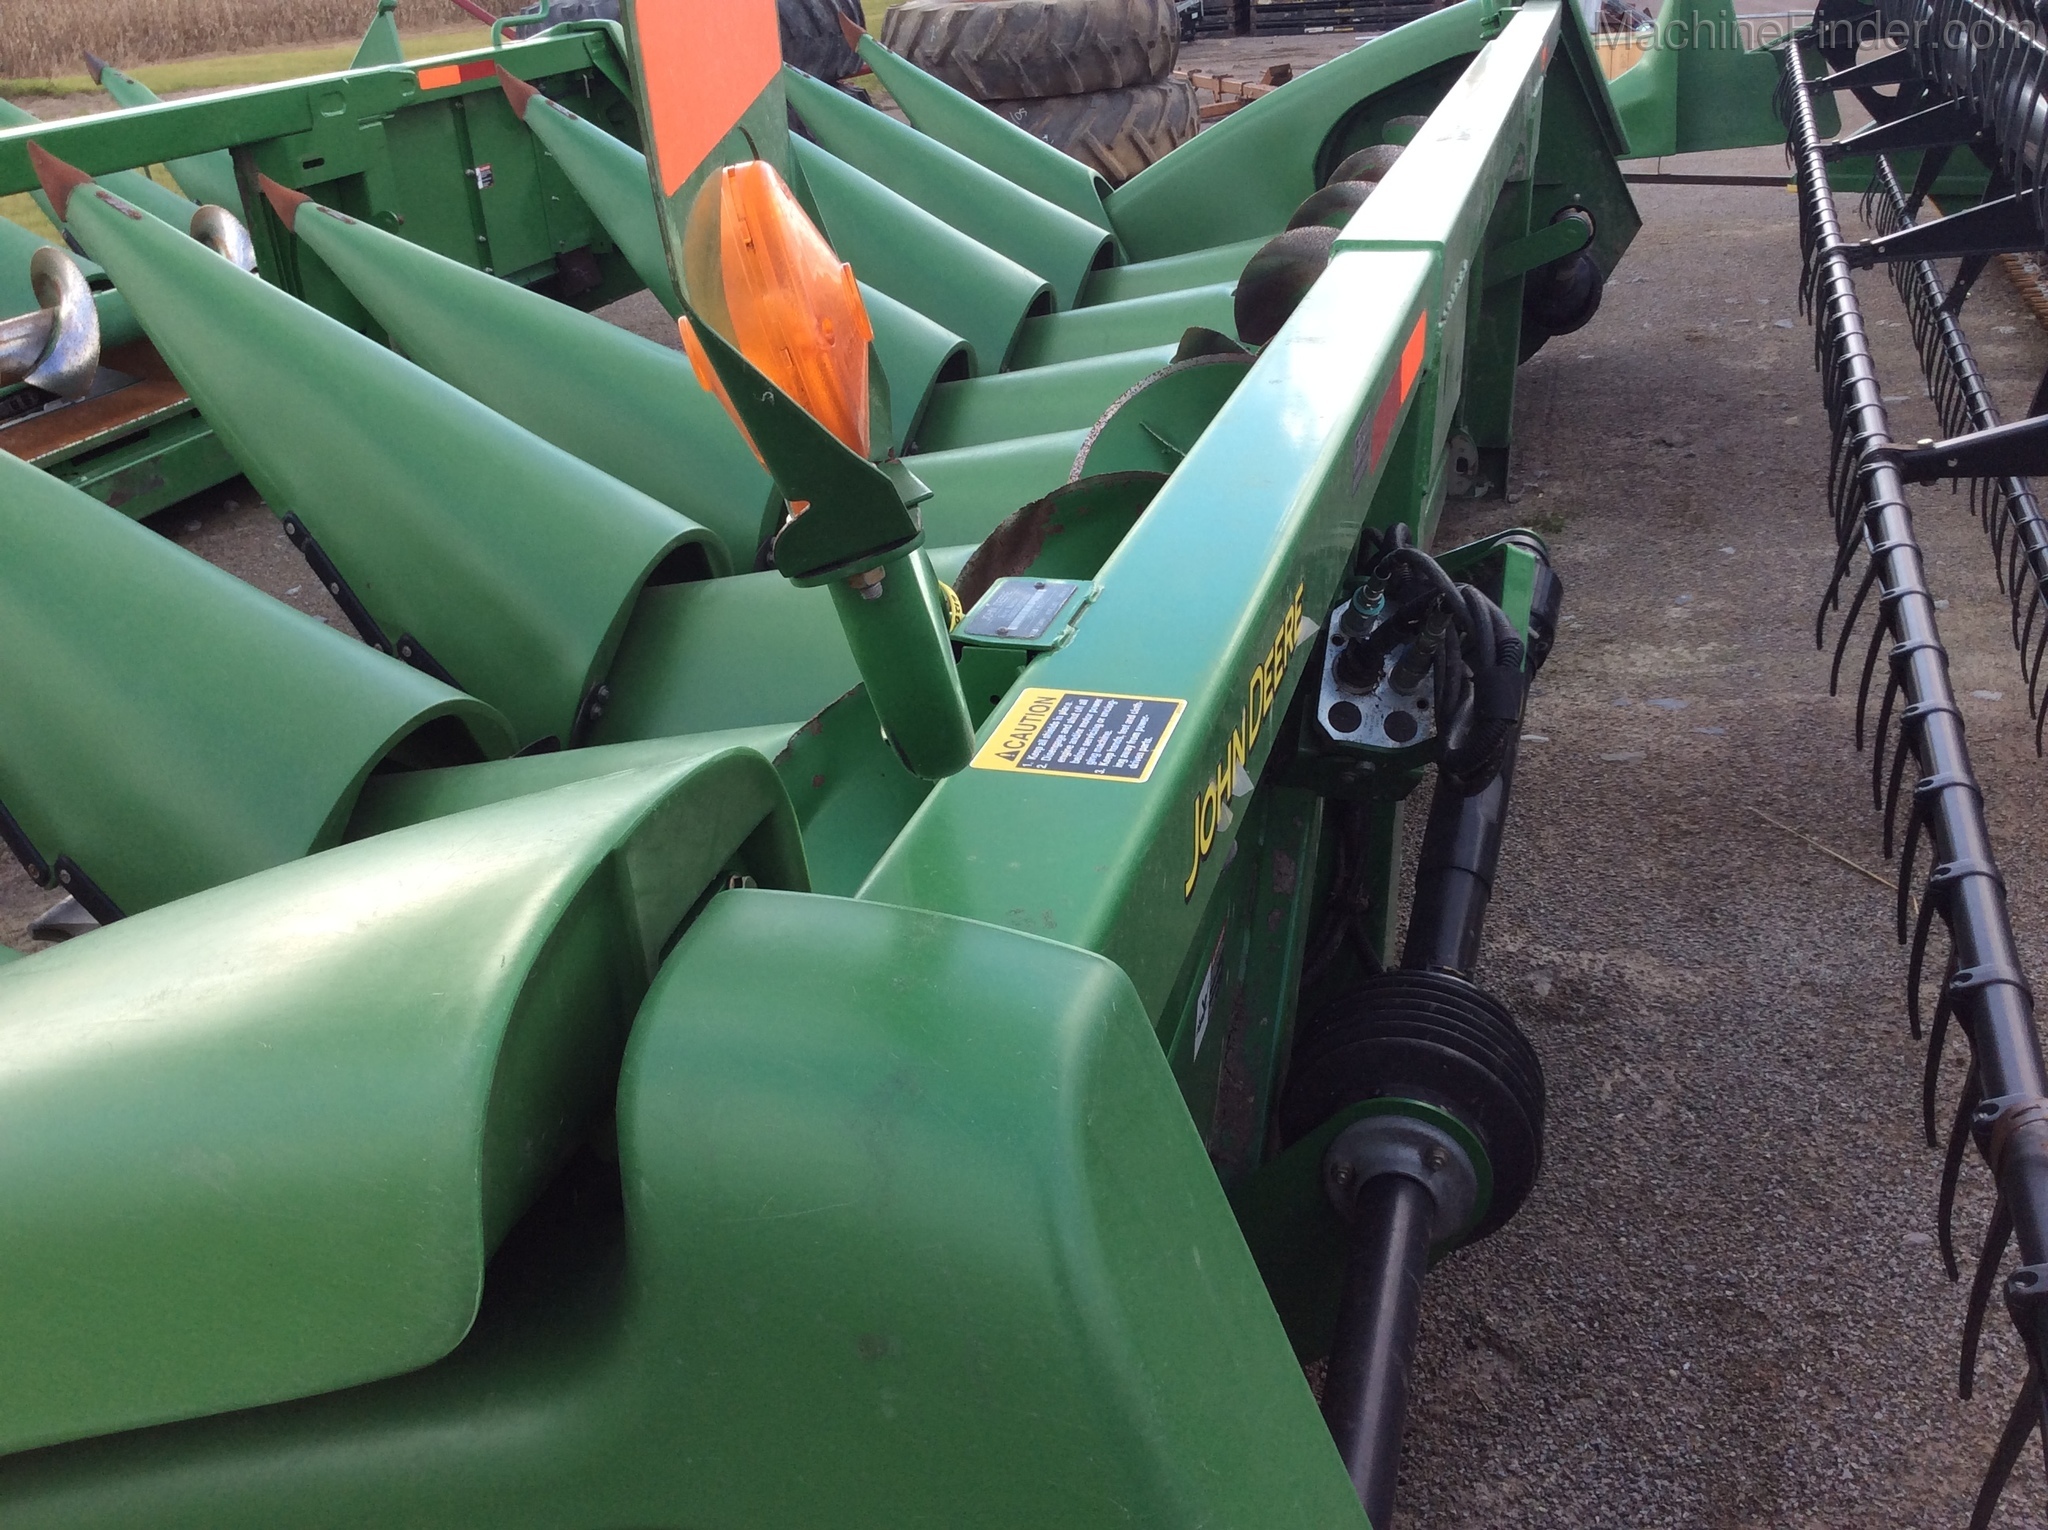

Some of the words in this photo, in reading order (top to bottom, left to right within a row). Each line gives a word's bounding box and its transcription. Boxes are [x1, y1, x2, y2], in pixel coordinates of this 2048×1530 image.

[1003, 697, 1057, 749] CAUTION
[1184, 703, 1247, 905] JOHN
[1248, 582, 1304, 750] DEERE
